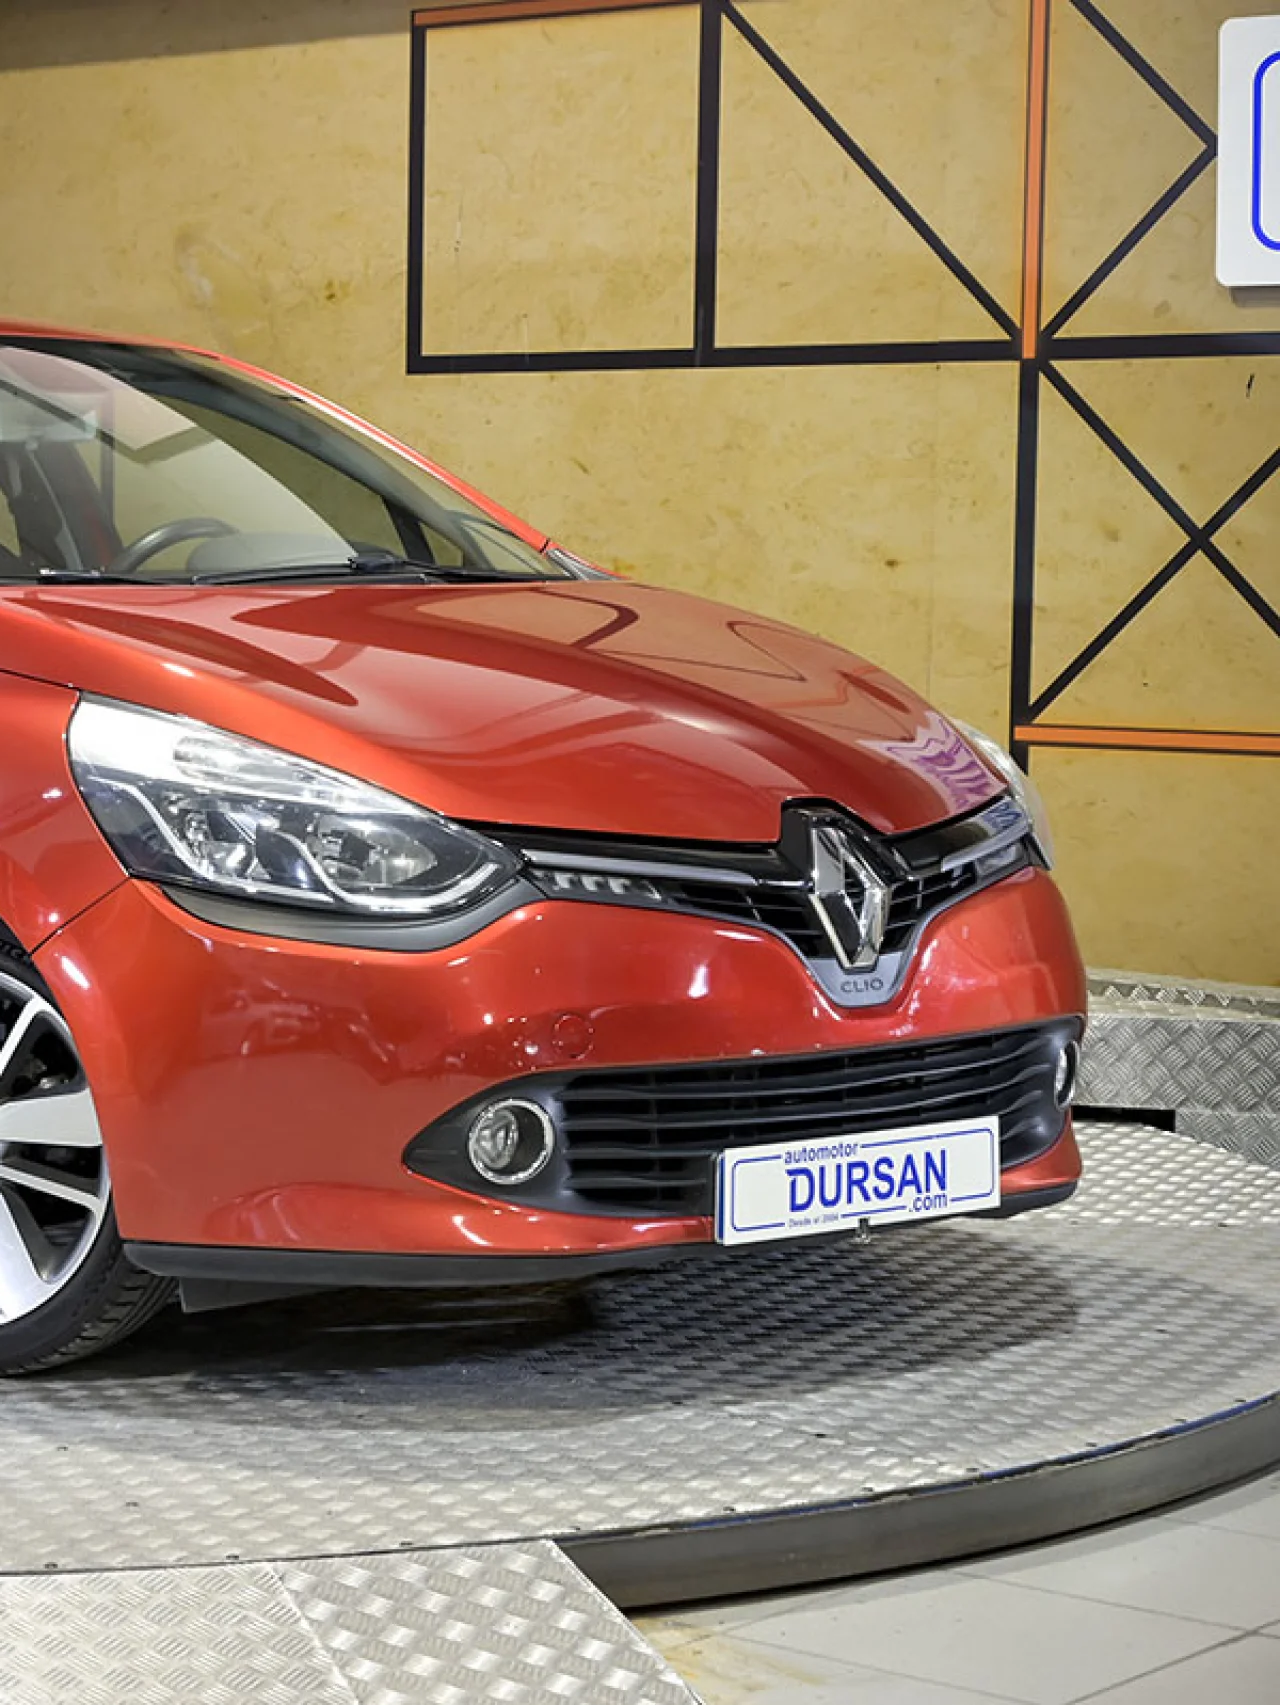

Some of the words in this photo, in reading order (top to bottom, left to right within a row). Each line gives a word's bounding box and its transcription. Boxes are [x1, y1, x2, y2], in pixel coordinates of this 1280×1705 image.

[840, 977, 884, 993] CLIO
[784, 1142, 859, 1164] automotor
[785, 1149, 947, 1213] DURSAN
[908, 1193, 948, 1213] .com
